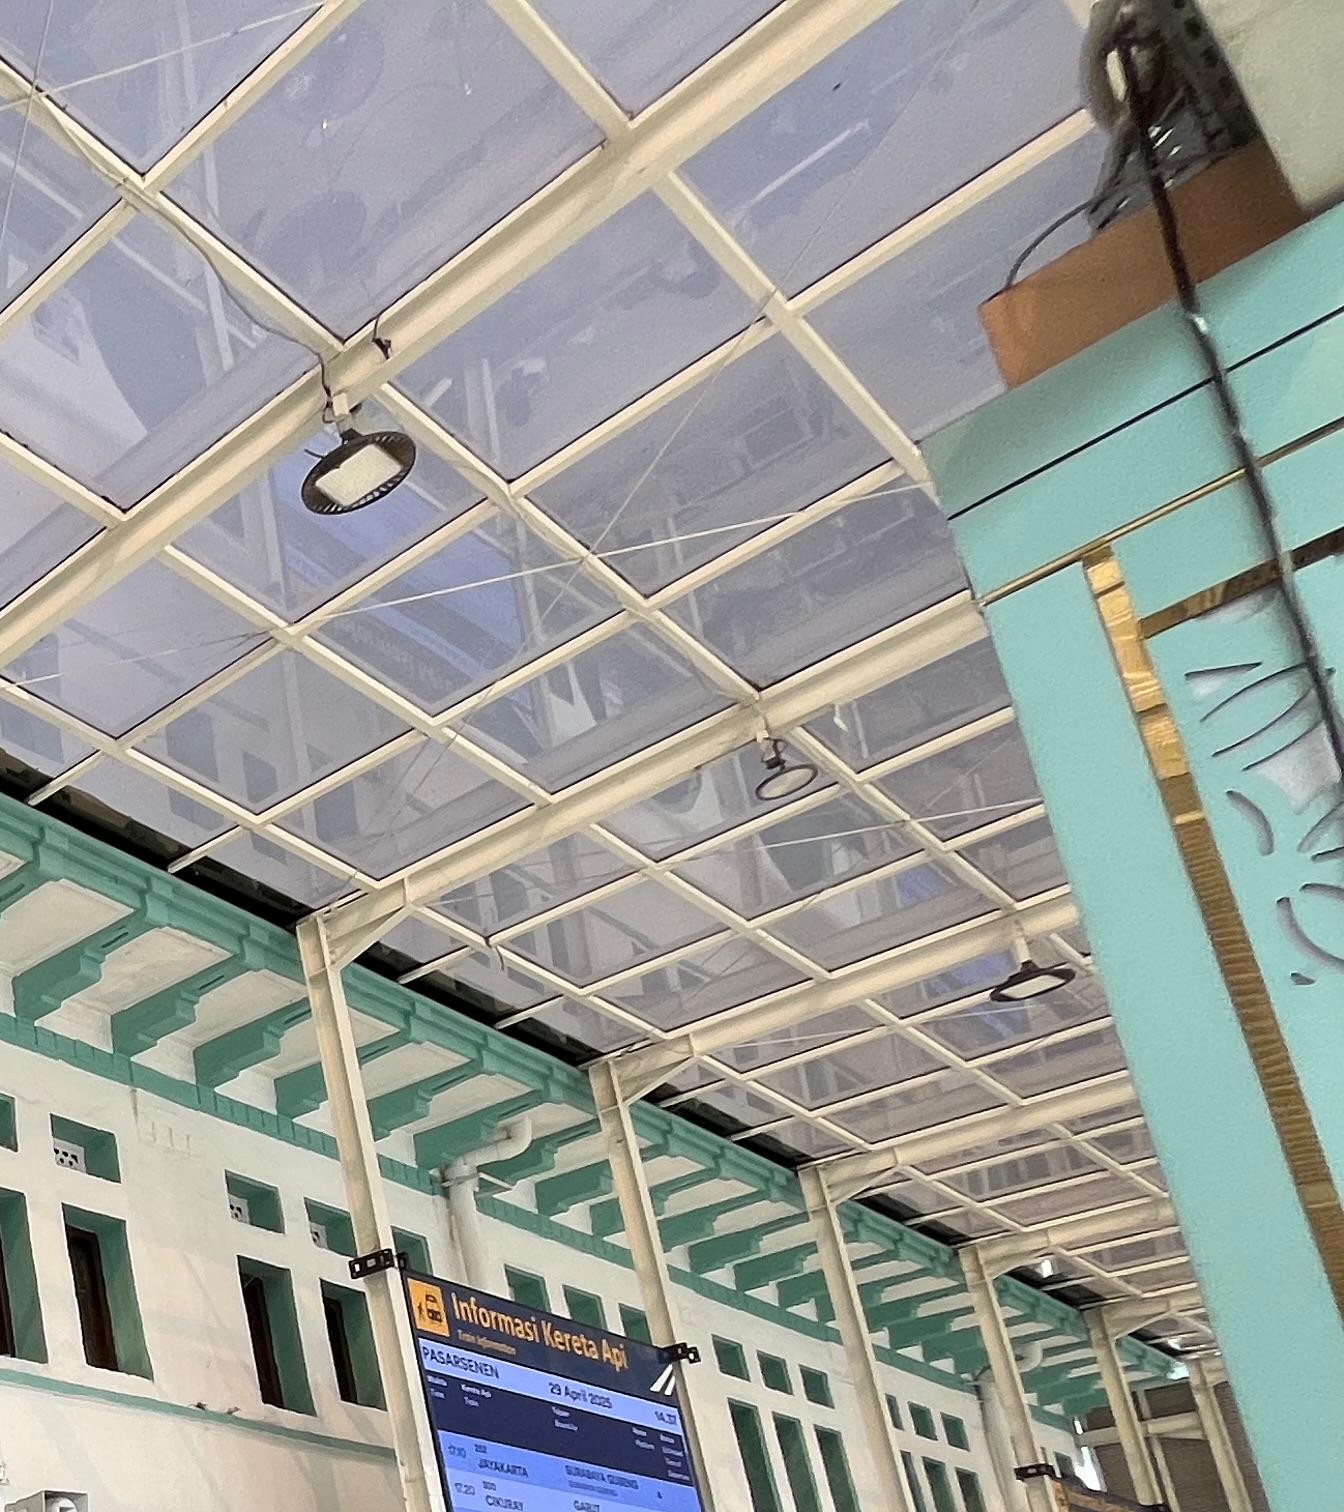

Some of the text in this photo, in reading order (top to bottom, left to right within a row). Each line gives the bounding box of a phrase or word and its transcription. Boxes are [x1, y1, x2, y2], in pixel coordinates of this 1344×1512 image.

[451, 1292, 540, 1343] Informasi
[541, 1320, 599, 1360] Kereta
[601, 1338, 630, 1372] Api
[421, 1346, 500, 1380] PASARSENEN
[564, 1385, 588, 1402] April
